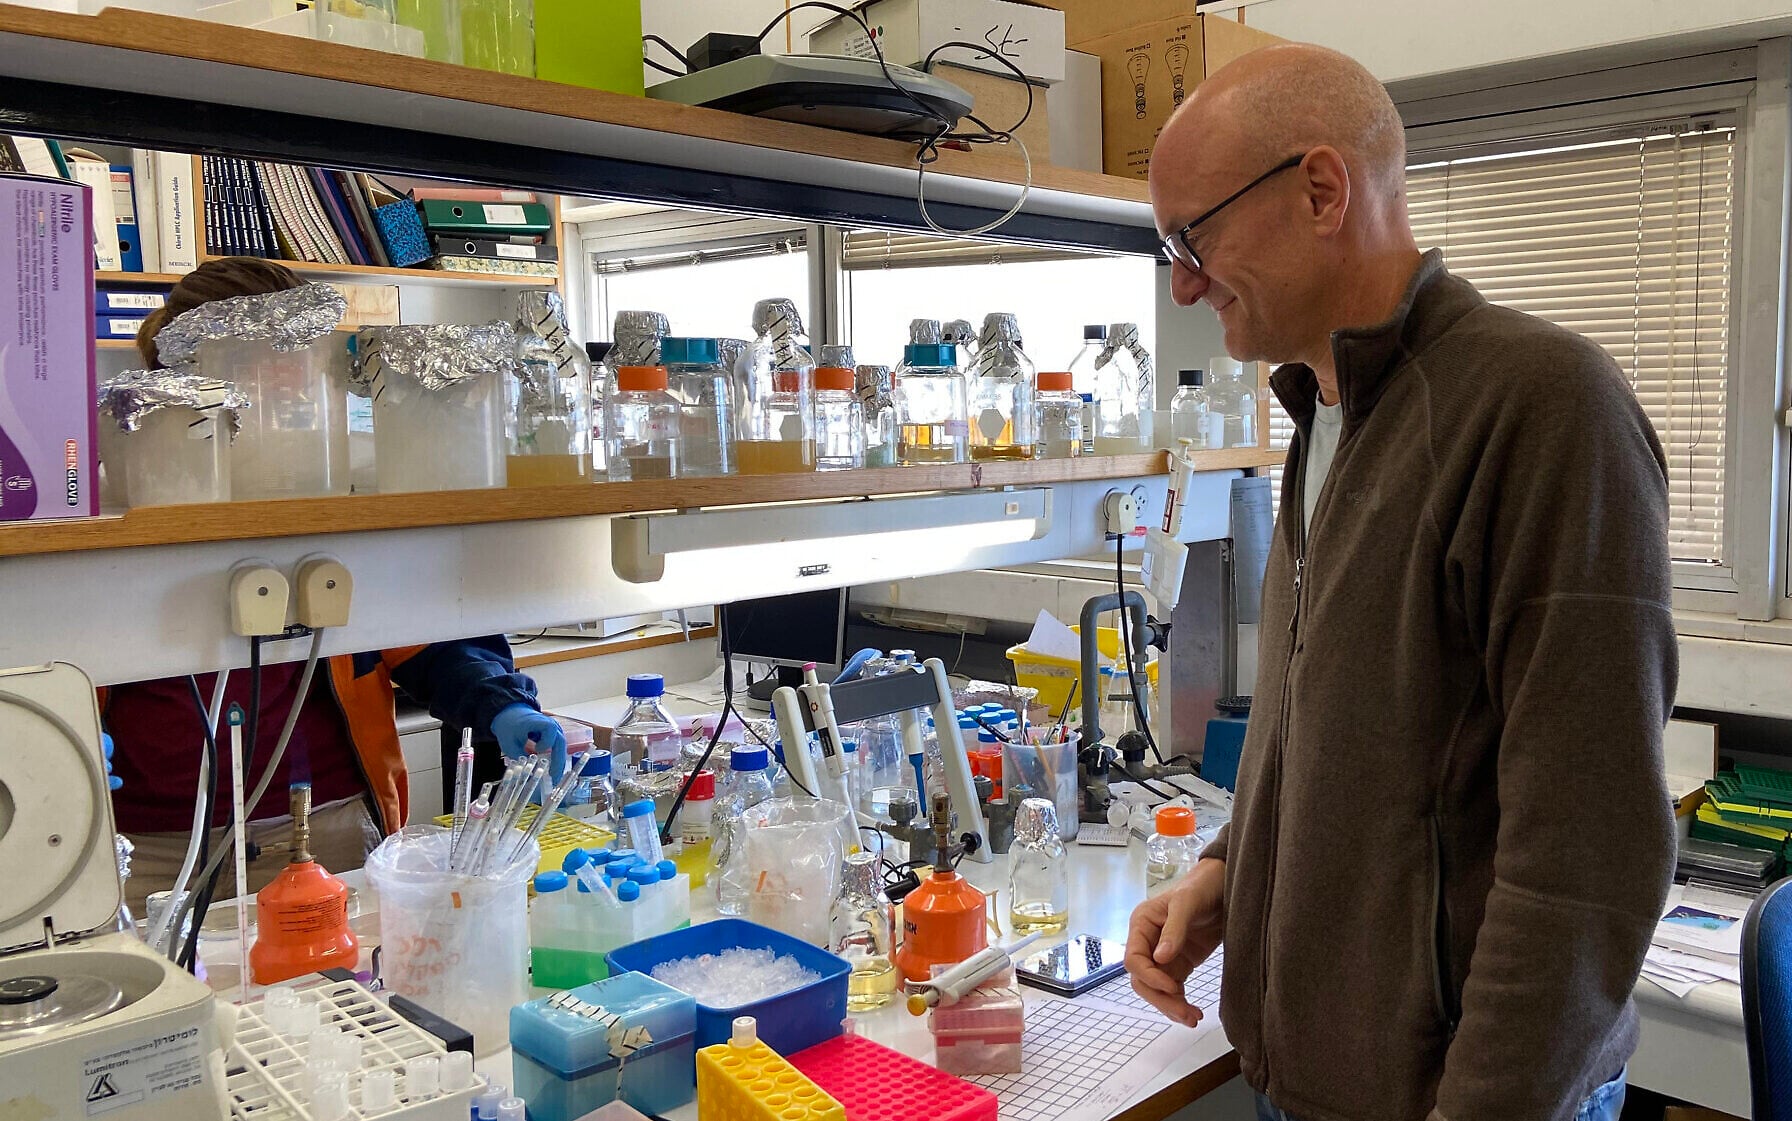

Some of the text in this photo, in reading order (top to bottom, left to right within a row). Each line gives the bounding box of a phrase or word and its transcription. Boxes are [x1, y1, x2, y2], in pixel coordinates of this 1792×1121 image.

[60, 193, 74, 233] Nitrile
[173, 192, 181, 220] Application
[66, 442, 77, 504] RHENGLOVE
[154, 1028, 198, 1048] לומיטרון
[85, 1059, 129, 1076] Lumitron
